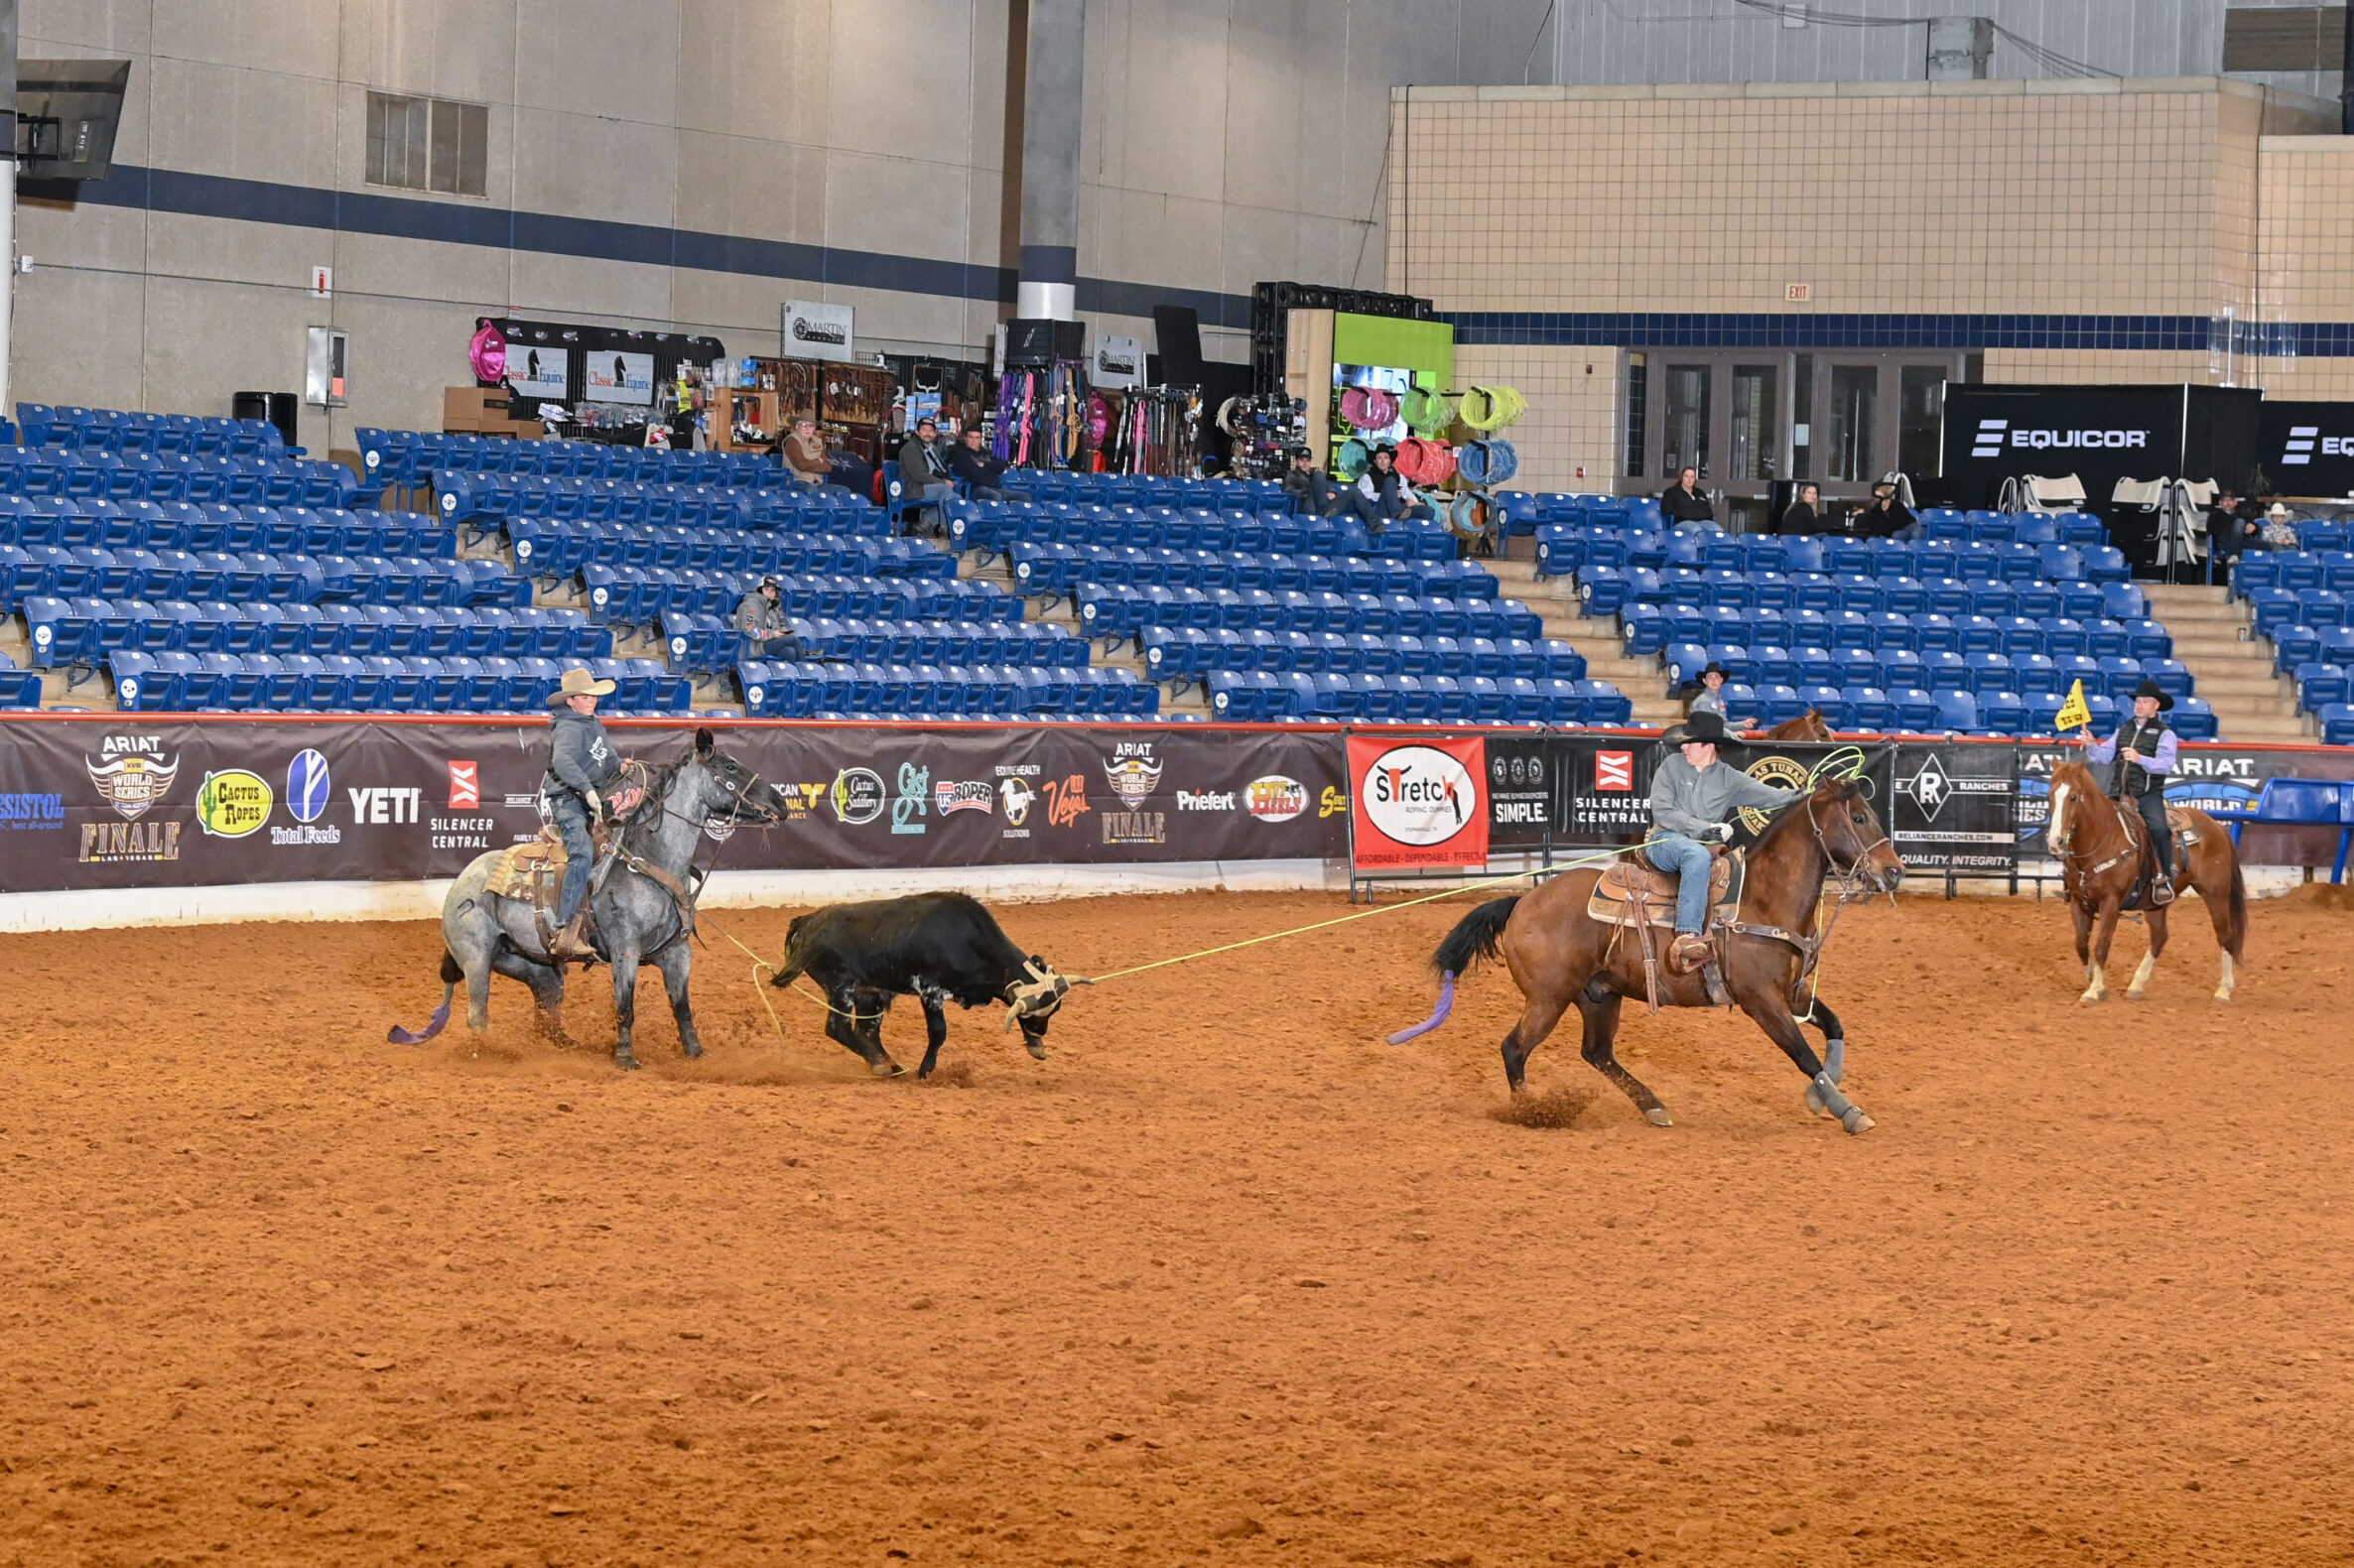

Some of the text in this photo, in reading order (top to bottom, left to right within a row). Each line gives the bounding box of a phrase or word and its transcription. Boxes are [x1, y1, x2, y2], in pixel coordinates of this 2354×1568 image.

[1789, 285, 1807, 299] EXIT
[807, 322, 847, 337] MARTIN
[506, 365, 566, 385] lassic Equine
[588, 371, 651, 391] Classic Equine
[2012, 430, 2146, 450] EQUICOR
[2322, 437, 2354, 457] EQ
[103, 736, 161, 752] ARIAT
[1115, 742, 1152, 756] ARIAT
[1017, 764, 1040, 775] HEALTH
[1755, 762, 1804, 785] AS TUNAS
[112, 773, 153, 786] WORLD
[850, 776, 874, 794] Cactus
[1959, 782, 2009, 791] RANCHES
[114, 786, 151, 800] SERIES
[218, 782, 260, 804] CACTUS
[846, 793, 876, 812] Saddlery
[955, 782, 992, 804] ROPER
[1176, 788, 1236, 811] Priefert
[348, 787, 419, 824] YETI
[1042, 778, 1092, 828] Vegas
[1576, 797, 1651, 810] SILENCER
[224, 804, 261, 825] ROPES
[1496, 803, 1548, 823] SIMPLE.
[1578, 812, 1648, 823] CENTRAL
[431, 818, 493, 831] SILENCER
[1102, 812, 1165, 844] FINALE
[78, 822, 181, 862] FINALE
[272, 825, 340, 844] Total Feeds
[433, 836, 488, 848] CENTRAL
[1897, 833, 1993, 842] RELIANCERANCHES.COM
[1899, 854, 2012, 866] QUALITY. INTEGRITY.
